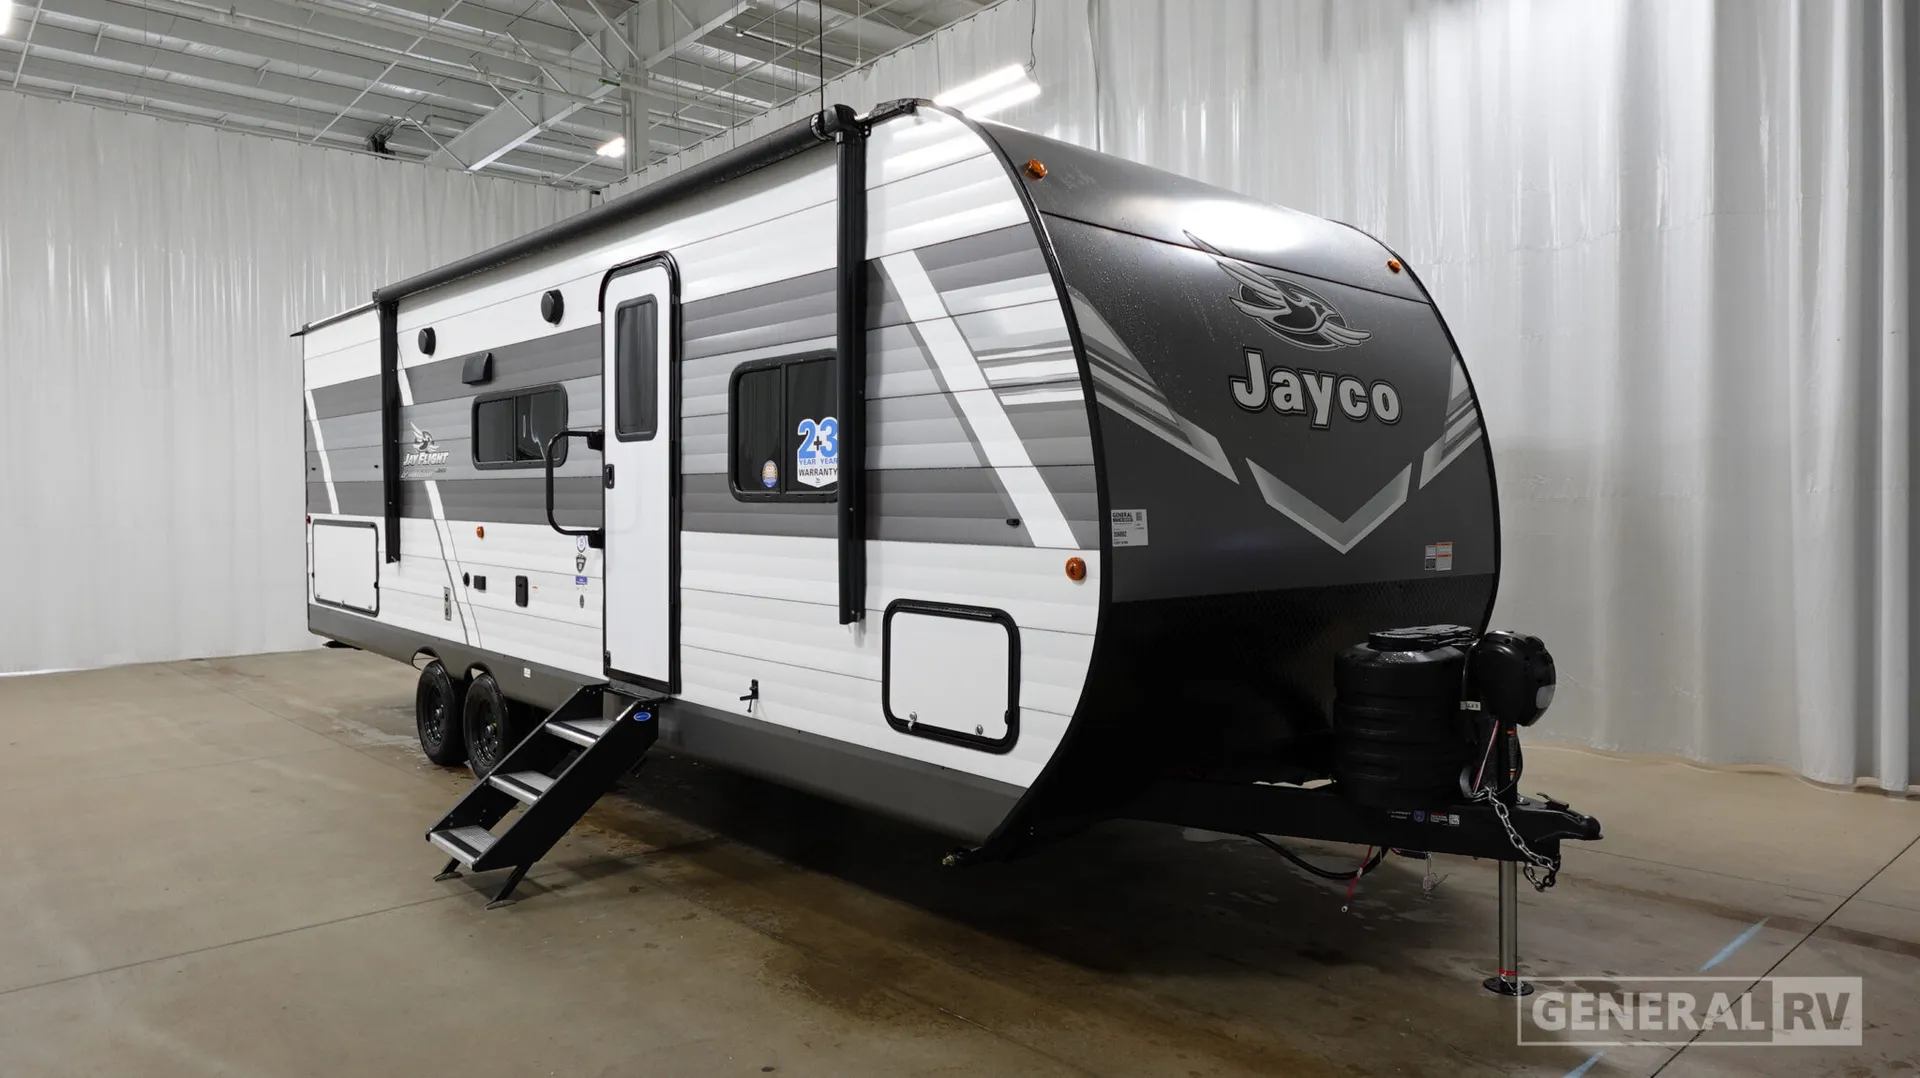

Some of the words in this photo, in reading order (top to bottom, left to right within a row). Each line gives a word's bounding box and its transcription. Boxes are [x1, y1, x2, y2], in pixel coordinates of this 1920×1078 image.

[1230, 349, 1401, 428] Jayco
[403, 453, 418, 466] JAY
[799, 468, 838, 477] WARRANTY
